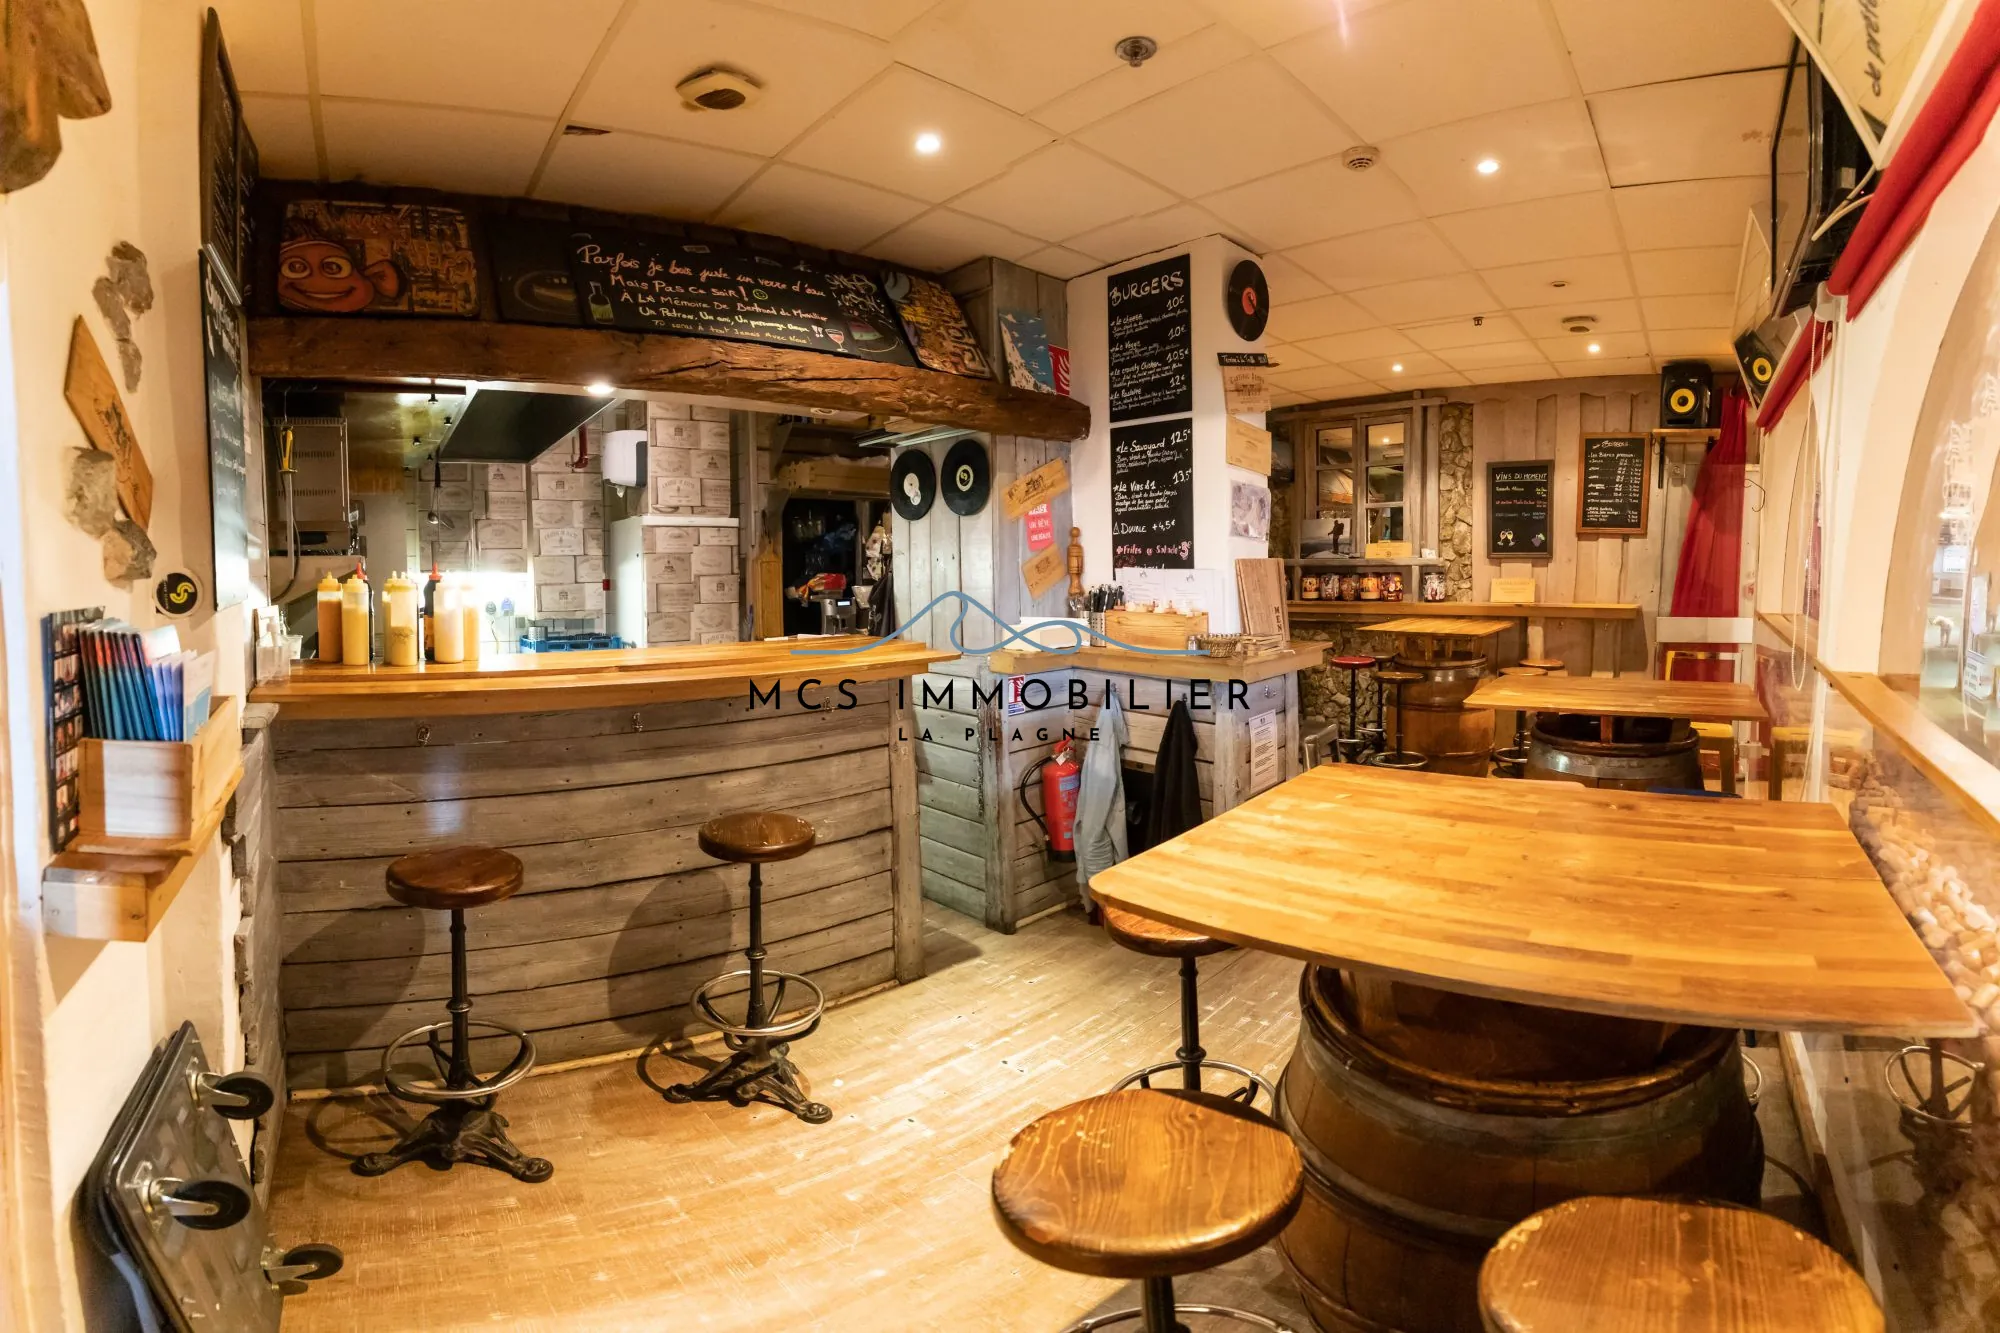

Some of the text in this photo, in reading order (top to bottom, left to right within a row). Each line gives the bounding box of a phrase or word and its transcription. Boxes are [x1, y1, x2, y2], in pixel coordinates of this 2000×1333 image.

[577, 244, 640, 273] Parfois
[647, 255, 664, 276] je
[669, 260, 693, 276] bois
[736, 275, 755, 284] un
[758, 278, 787, 290] verre
[610, 274, 648, 290] Mais
[652, 280, 684, 293] Pas
[1109, 271, 1184, 307] BURGERS
[661, 297, 710, 308] Mémoire
[1130, 438, 1165, 455] Savoyard
[1495, 471, 1511, 480] VINS
[1523, 472, 1547, 480] MOMENT
